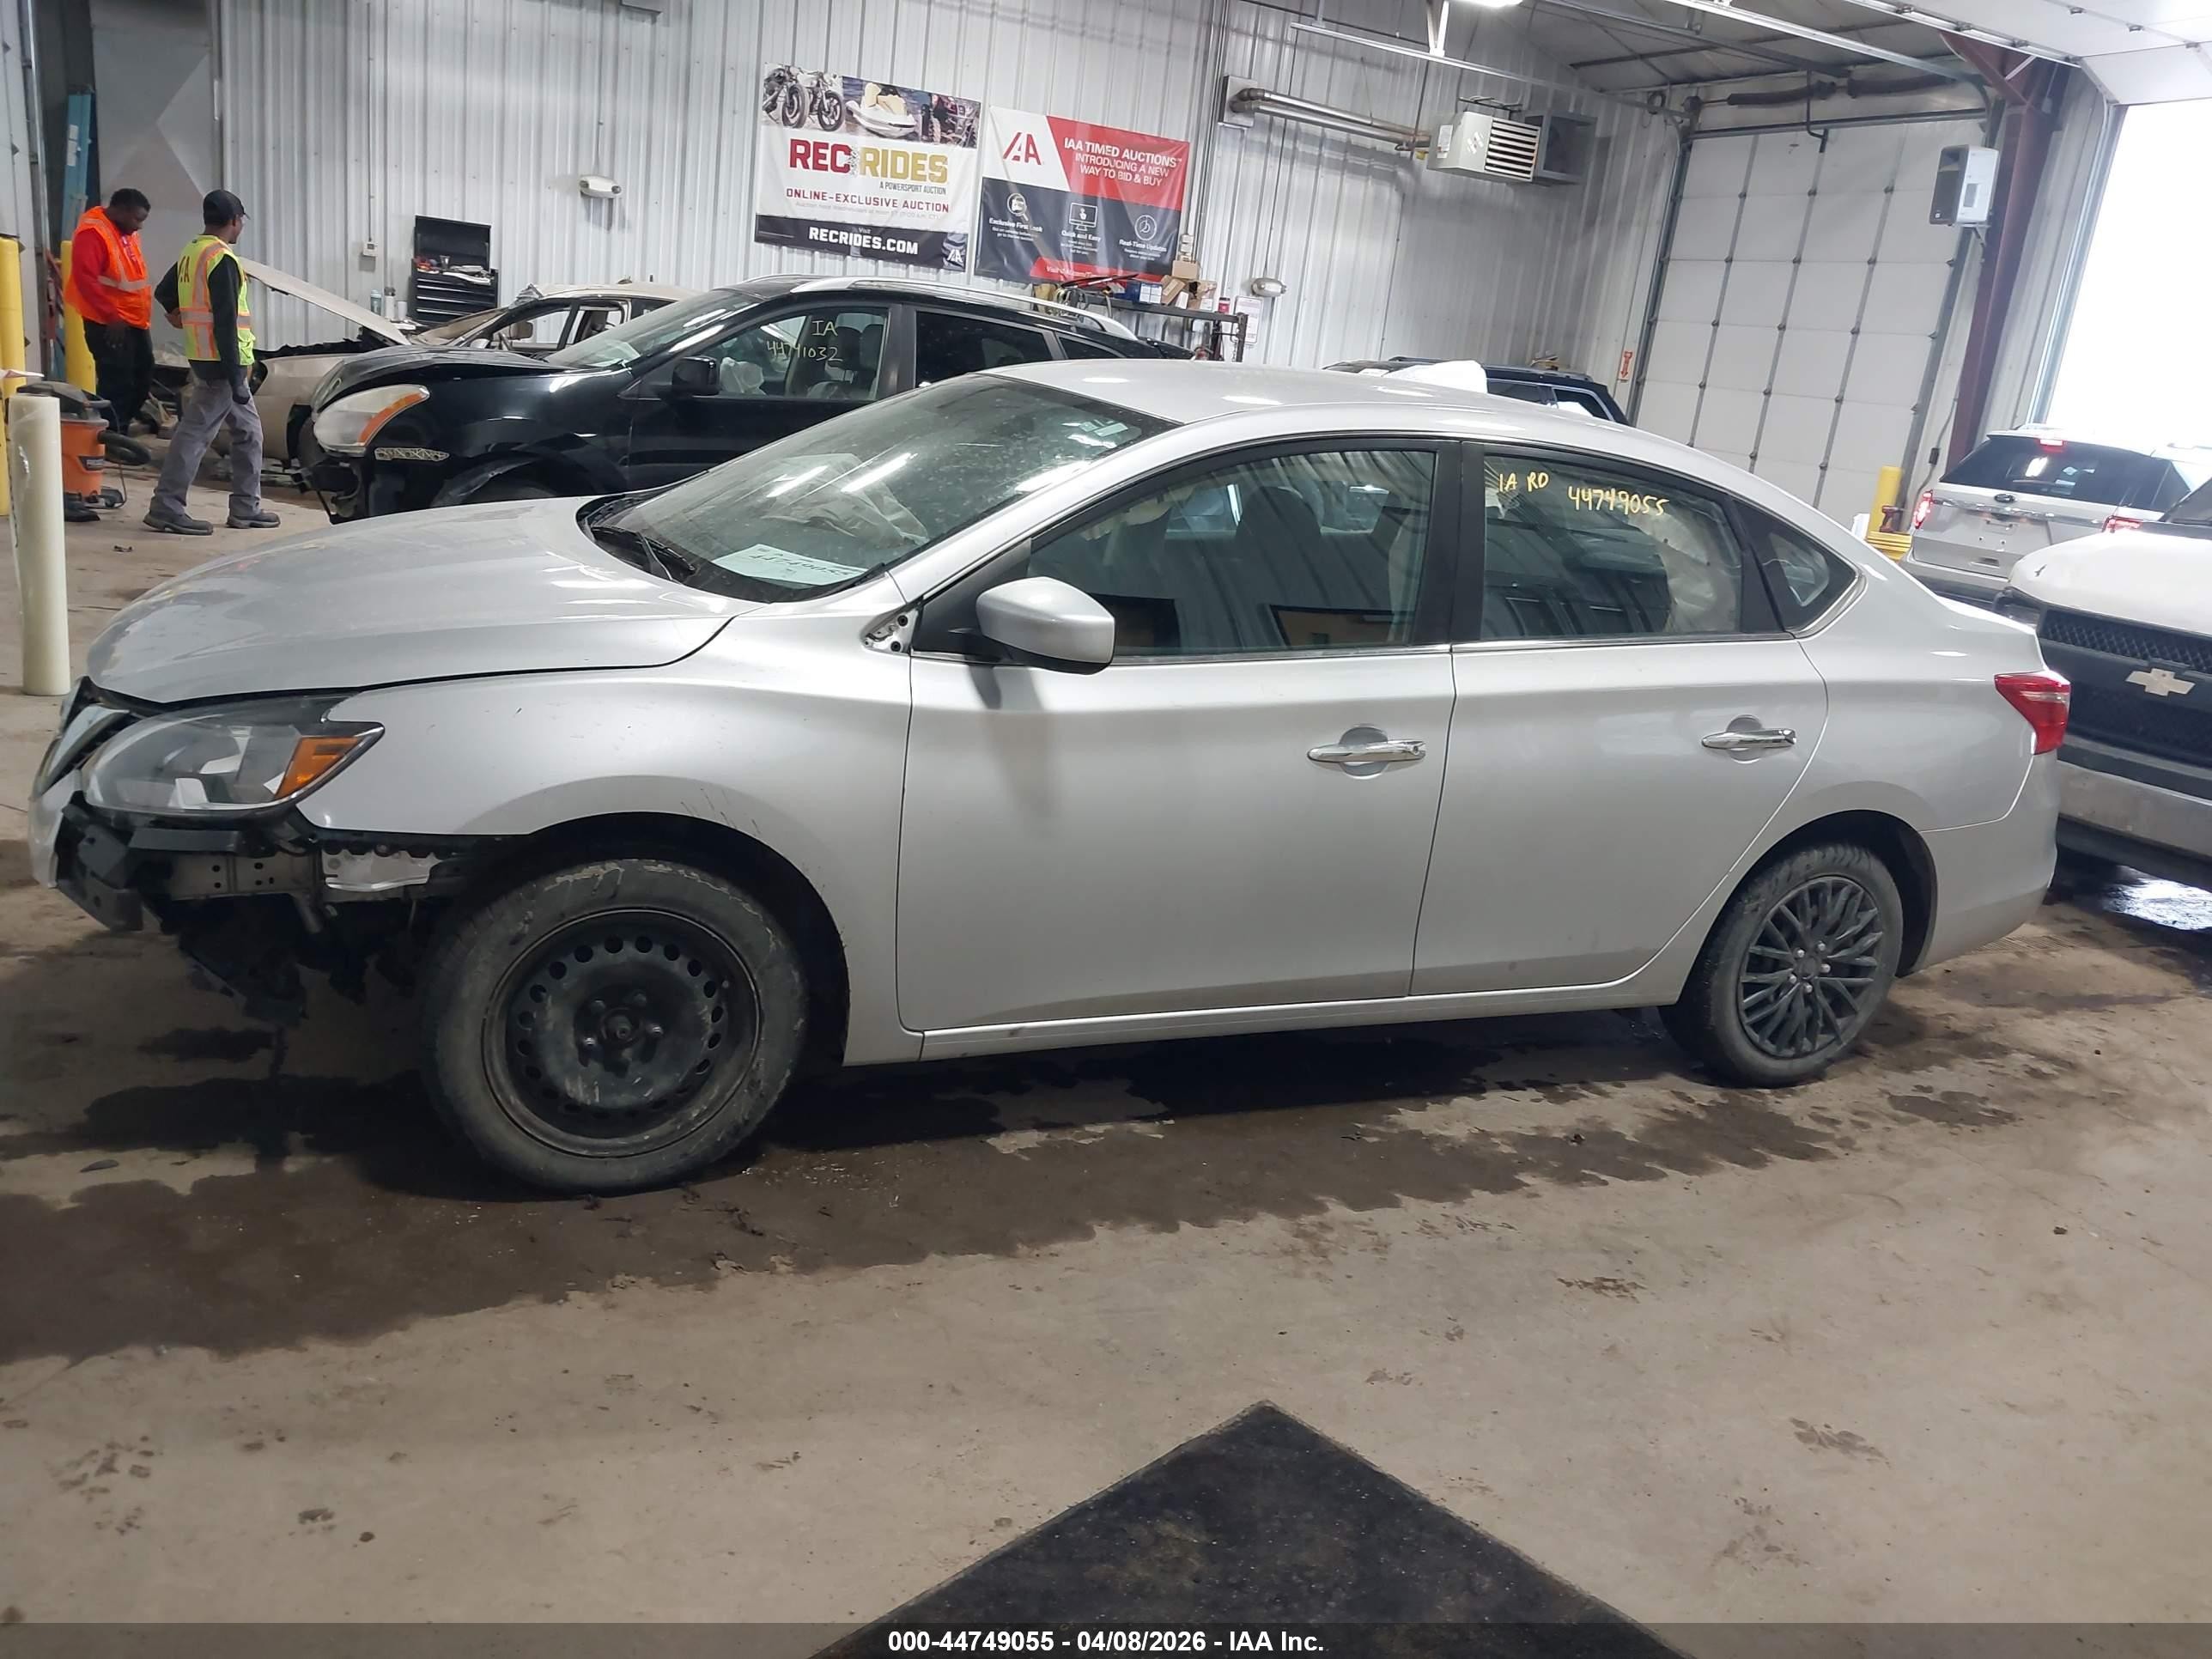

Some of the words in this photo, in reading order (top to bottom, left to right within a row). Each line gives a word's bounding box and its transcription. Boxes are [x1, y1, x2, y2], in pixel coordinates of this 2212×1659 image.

[1064, 137, 1083, 151] IAA
[1085, 142, 1120, 158] TIMED
[790, 138, 853, 174] REC
[860, 147, 948, 184] RIDES
[1075, 153, 1137, 172] INTRODUCING
[1139, 164, 1146, 173] A
[1148, 166, 1170, 178] NEW
[1079, 164, 1101, 177] WAY
[1103, 168, 1115, 179] TO
[1117, 171, 1132, 182] BID
[1133, 174, 1141, 184] &
[1143, 175, 1163, 186] BUY
[787, 187, 898, 209] ONLINE-EXCLUSIVE
[902, 199, 950, 213] AUCTION
[884, 181, 922, 193] POWERSPORT
[923, 185, 946, 195] AUCTION
[809, 226, 918, 255] RECRIDES.COM
[811, 319, 839, 337] IA
[1526, 471, 1549, 493] RD
[1567, 485, 1671, 517] 44749055
